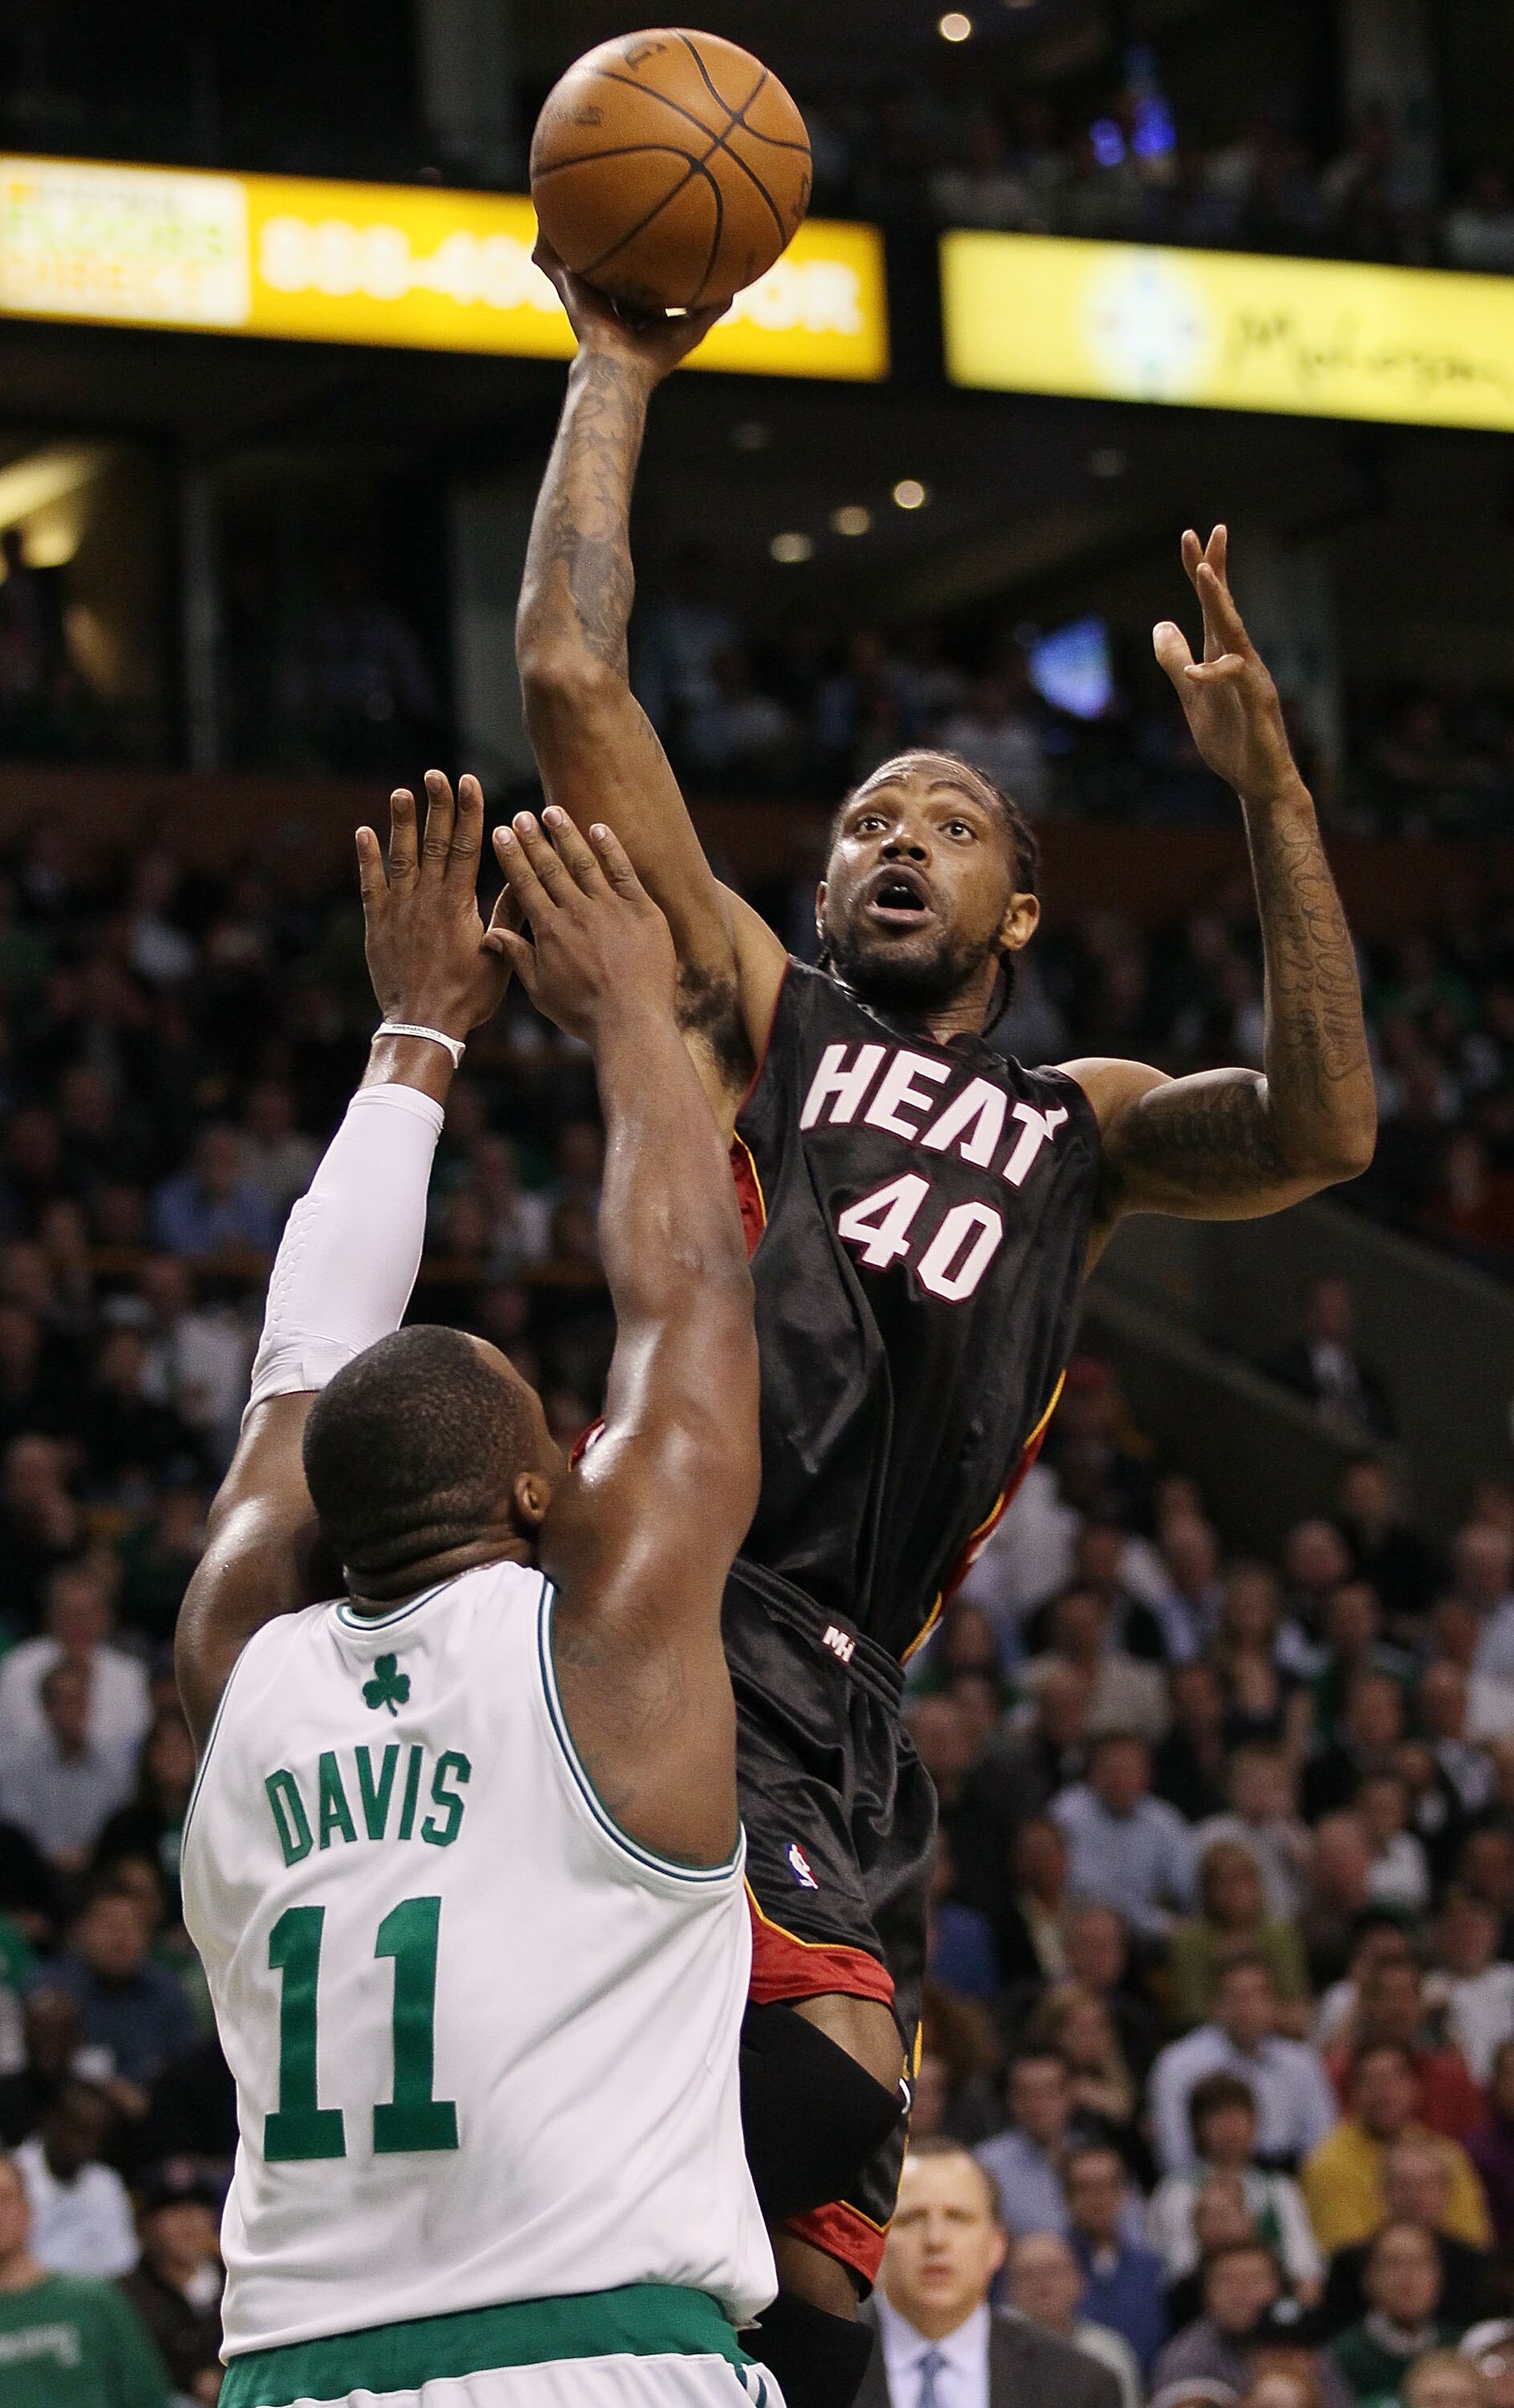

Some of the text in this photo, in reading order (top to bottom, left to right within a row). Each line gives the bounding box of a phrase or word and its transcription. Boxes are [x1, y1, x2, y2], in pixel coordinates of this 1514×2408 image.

[800, 1043, 1069, 1187] HEAT
[837, 1172, 1003, 1302] 40
[265, 1744, 472, 1868] DAVIS
[264, 1895, 459, 2162] 11
